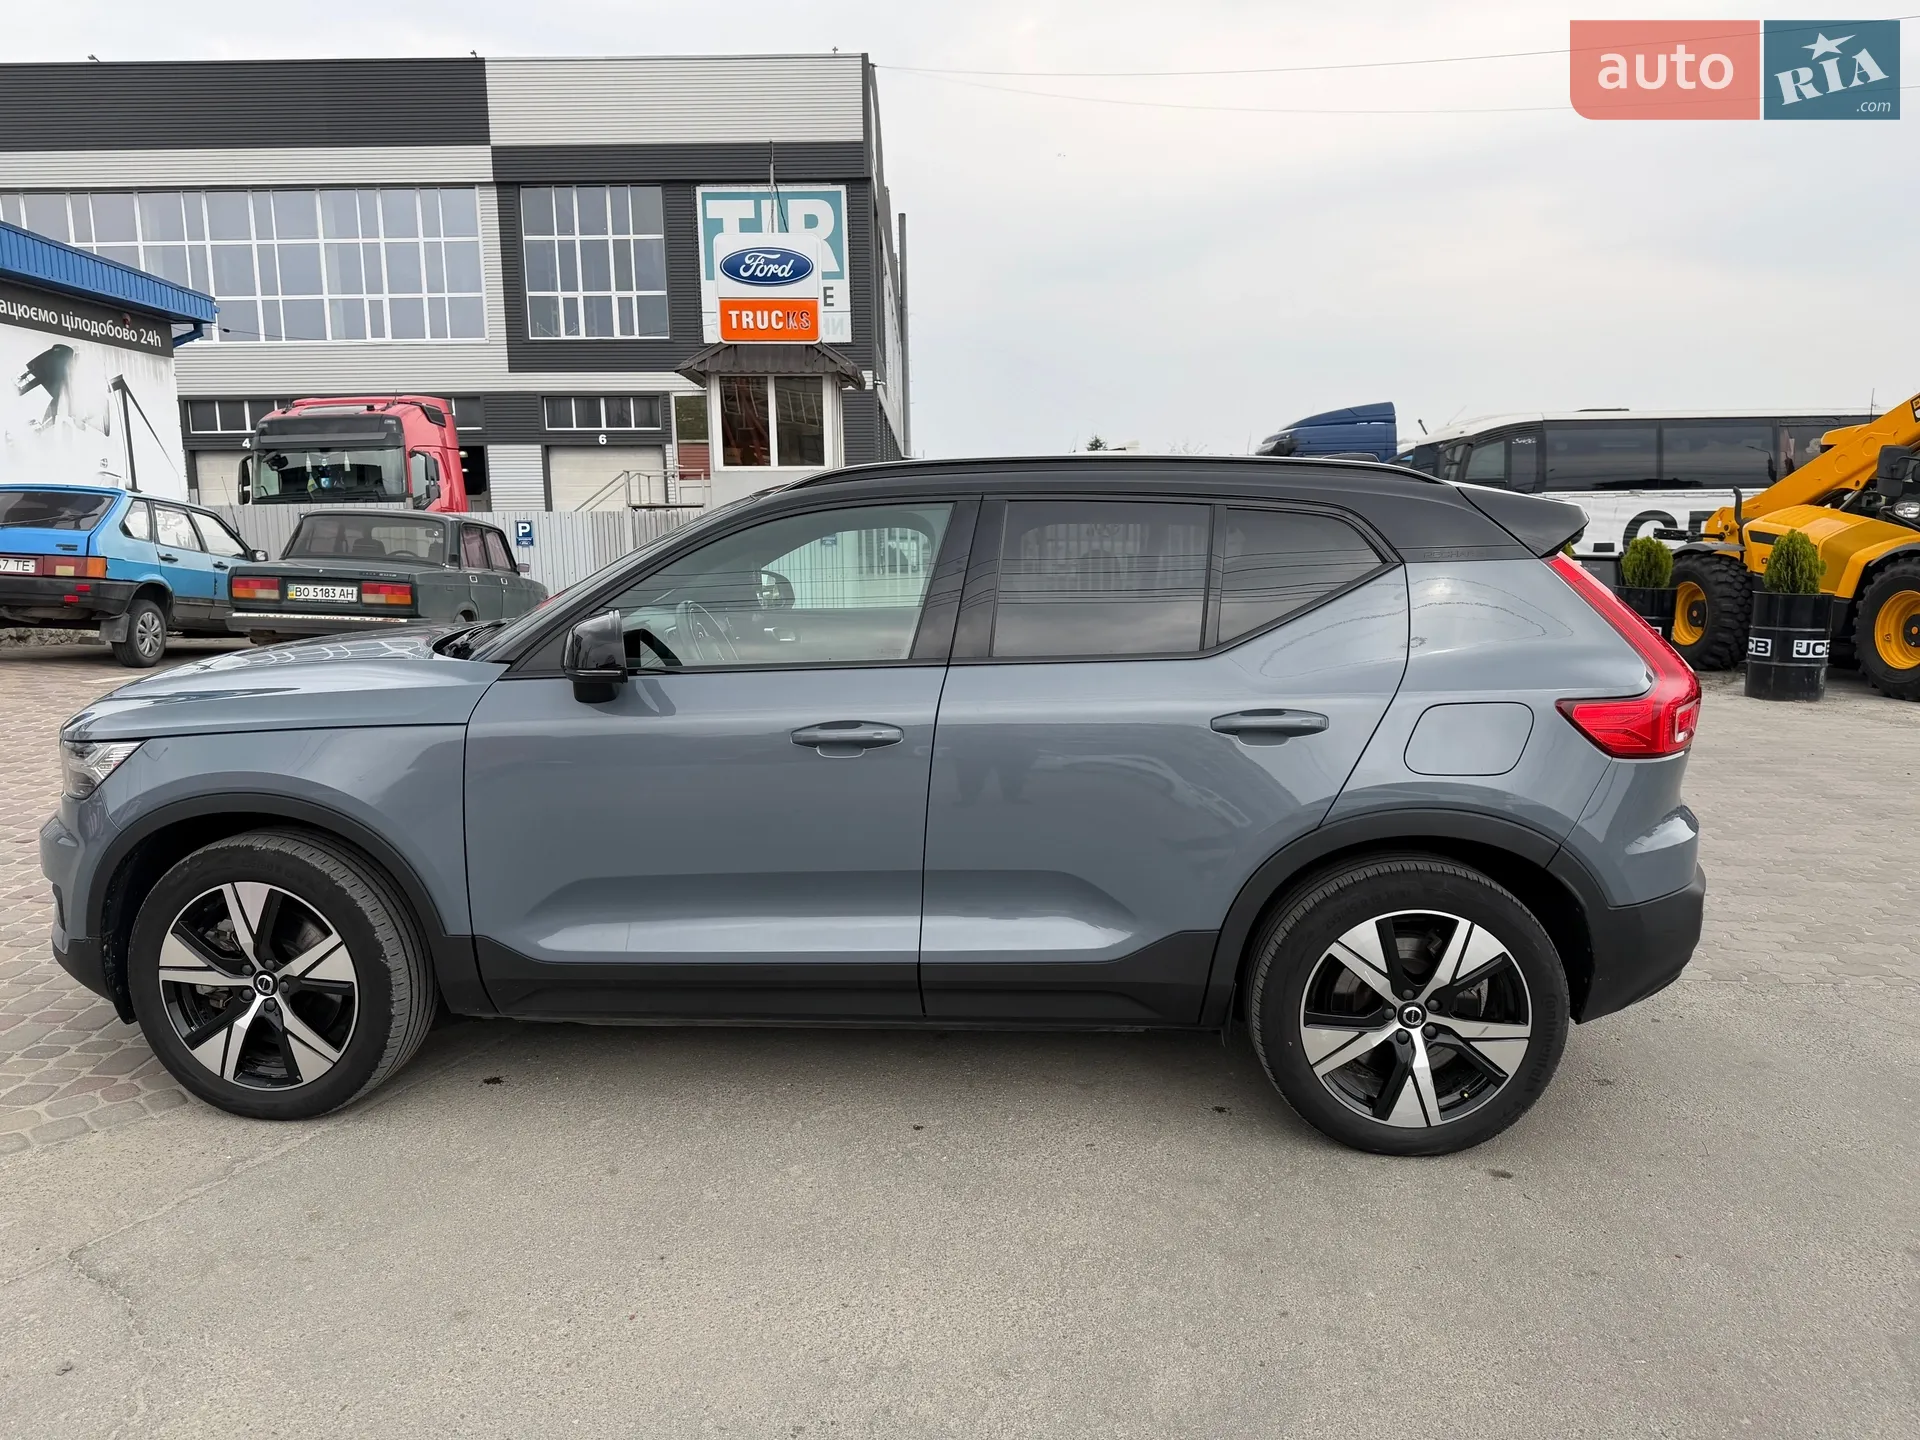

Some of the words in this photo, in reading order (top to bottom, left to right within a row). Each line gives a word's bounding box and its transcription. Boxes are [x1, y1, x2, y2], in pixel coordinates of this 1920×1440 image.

[739, 252, 795, 278] Ford
[728, 310, 811, 330] TRUCKS
[61, 311, 138, 343] цілодобово
[140, 328, 162, 347] 24h
[242, 437, 251, 449] 4
[598, 434, 607, 445] 6
[517, 522, 531, 537] P
[14, 560, 31, 571] TE
[294, 586, 310, 598] BO
[312, 587, 336, 599] 5183
[338, 588, 355, 599] AH
